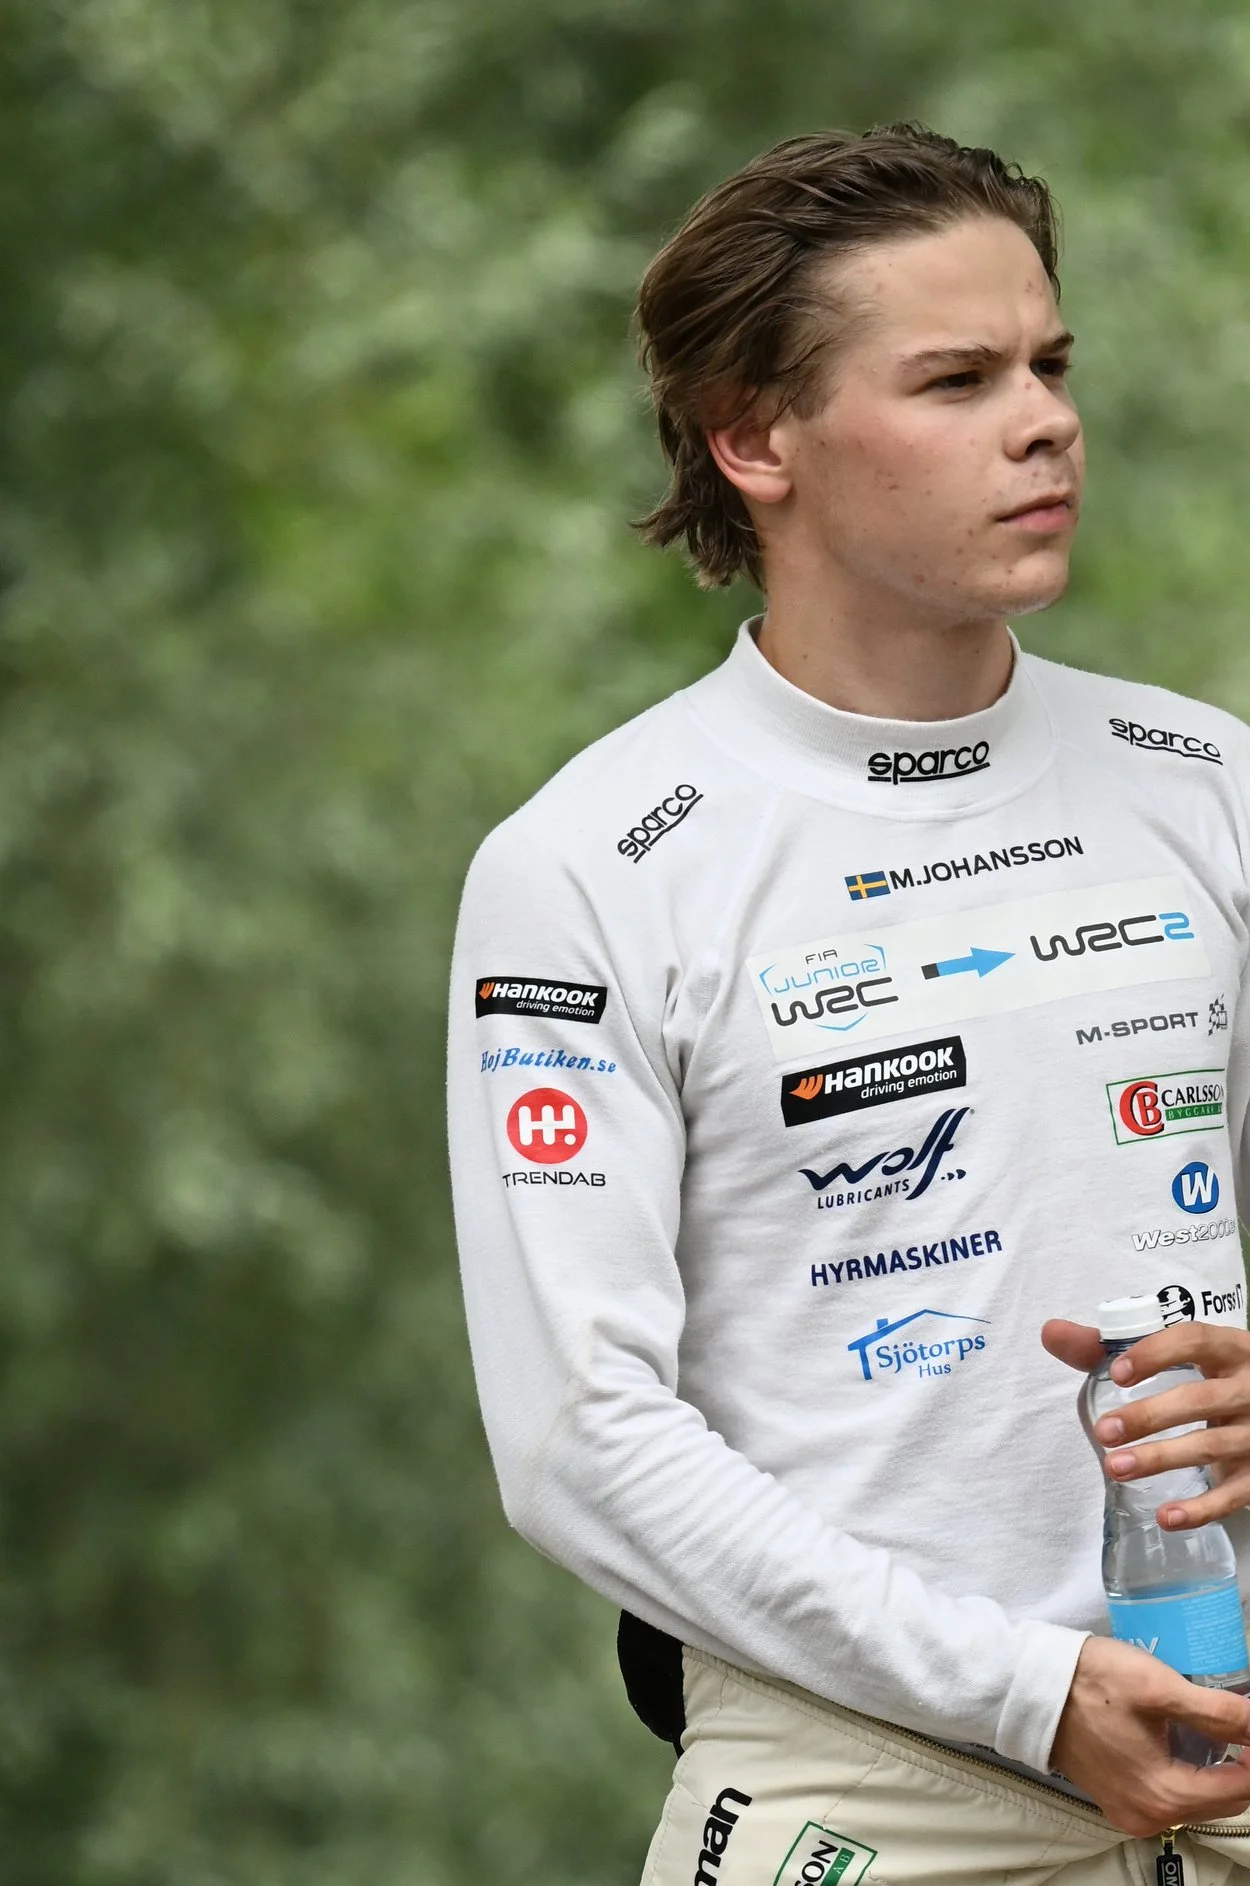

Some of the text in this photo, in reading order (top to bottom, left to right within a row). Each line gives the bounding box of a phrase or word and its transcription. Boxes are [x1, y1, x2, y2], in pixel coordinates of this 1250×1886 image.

[1109, 717, 1223, 765] sparco
[868, 741, 990, 784] sparco
[618, 784, 703, 863] sparco
[889, 836, 1083, 890] M.JOHANSSON
[1029, 911, 1195, 963] WRC2
[805, 948, 839, 965] FIA
[773, 959, 878, 993] JUNIOR
[516, 1000, 595, 1017] driving emotion
[770, 976, 900, 1027] WRC
[1075, 1011, 1199, 1046] M-SPORT
[861, 1068, 958, 1101] driving emotion
[502, 1171, 606, 1188] TRENDAB
[817, 1178, 910, 1210] LUBRICANTS
[810, 1230, 1002, 1287] HYRMASKINER
[876, 1333, 986, 1377] Sjötorps
[918, 1360, 952, 1379] Hus
[835, 1851, 852, 1876] AB
